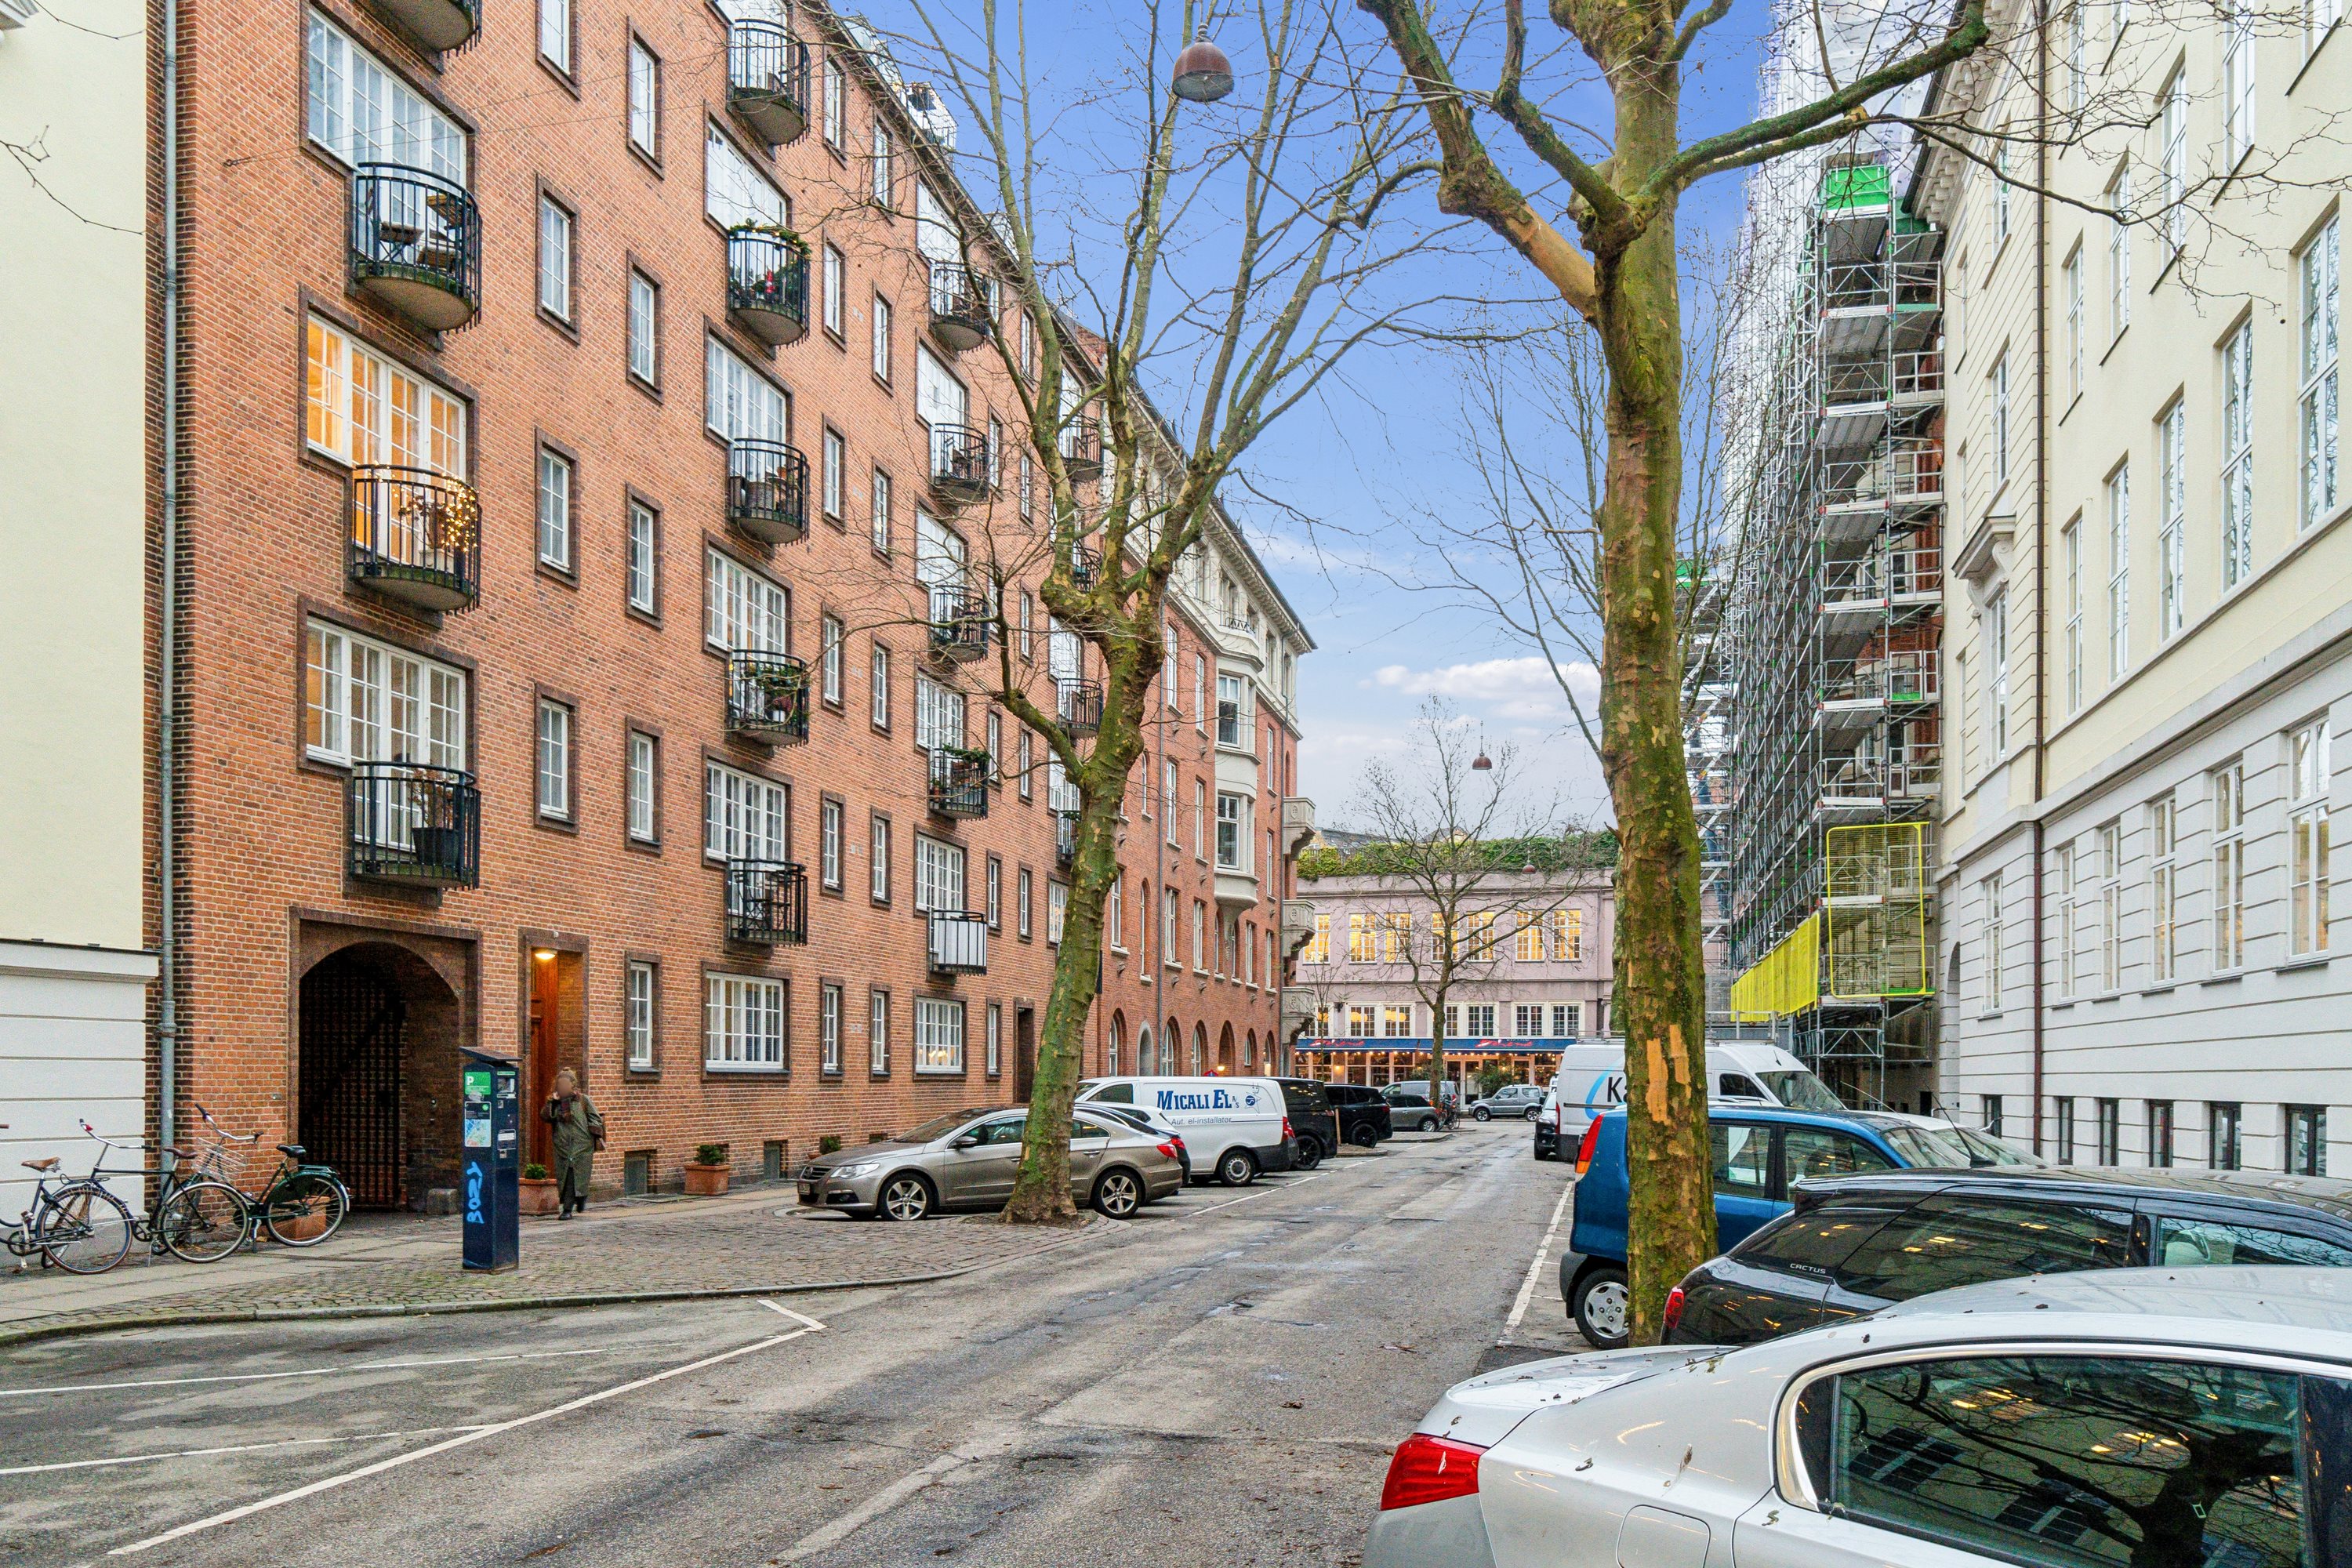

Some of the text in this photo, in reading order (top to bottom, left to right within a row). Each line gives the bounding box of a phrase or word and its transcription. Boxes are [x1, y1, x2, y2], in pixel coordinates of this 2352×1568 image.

[466, 1076, 474, 1086] P
[1157, 1091, 1210, 1110] MICALI
[1790, 1263, 1826, 1274] CACTUS
